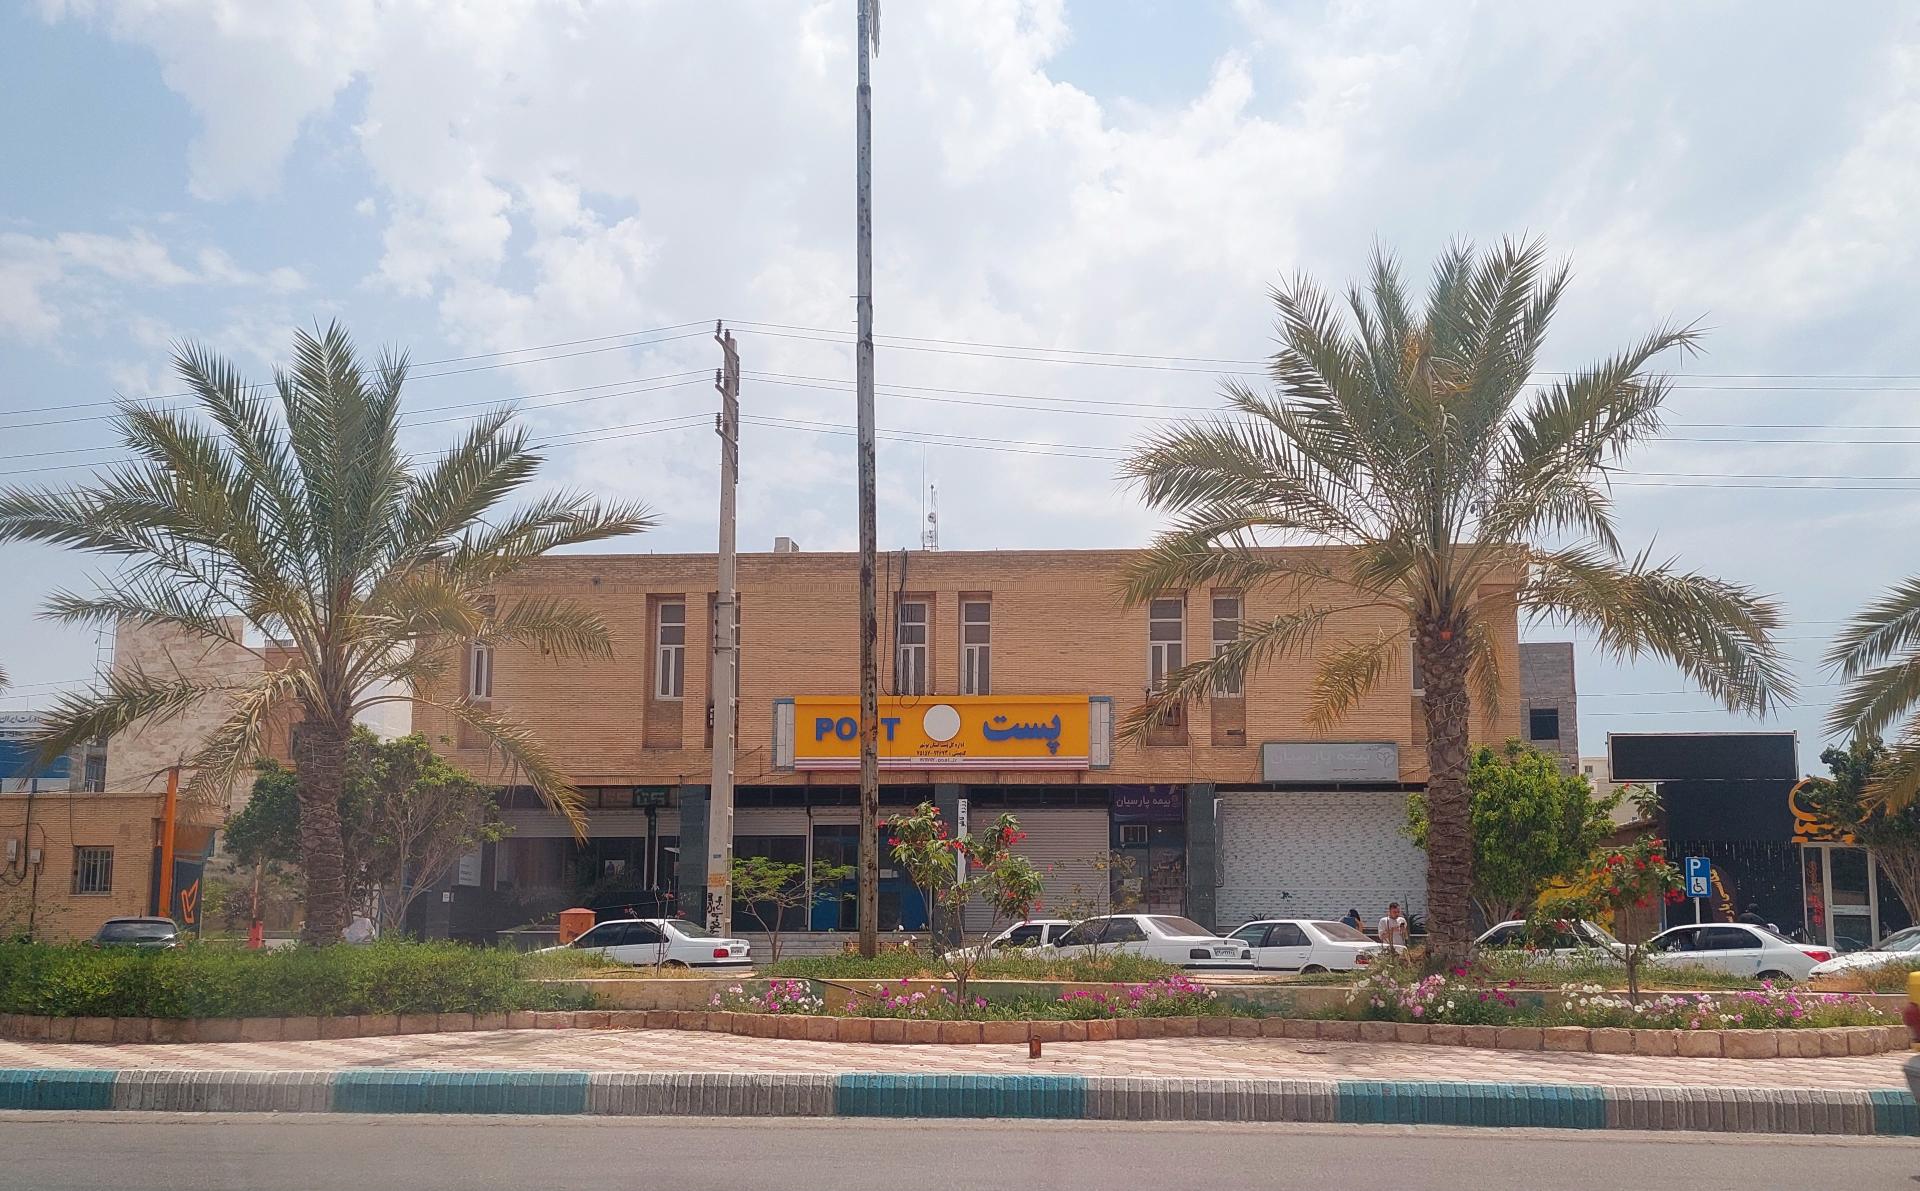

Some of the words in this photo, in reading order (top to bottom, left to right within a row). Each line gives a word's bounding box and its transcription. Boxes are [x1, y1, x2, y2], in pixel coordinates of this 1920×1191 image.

[815, 717, 901, 741] POT
[983, 714, 1061, 755] پست
[1116, 795, 1150, 809] پارسیان
[1152, 797, 1171, 808] بیمه
[1690, 859, 1701, 876] P
